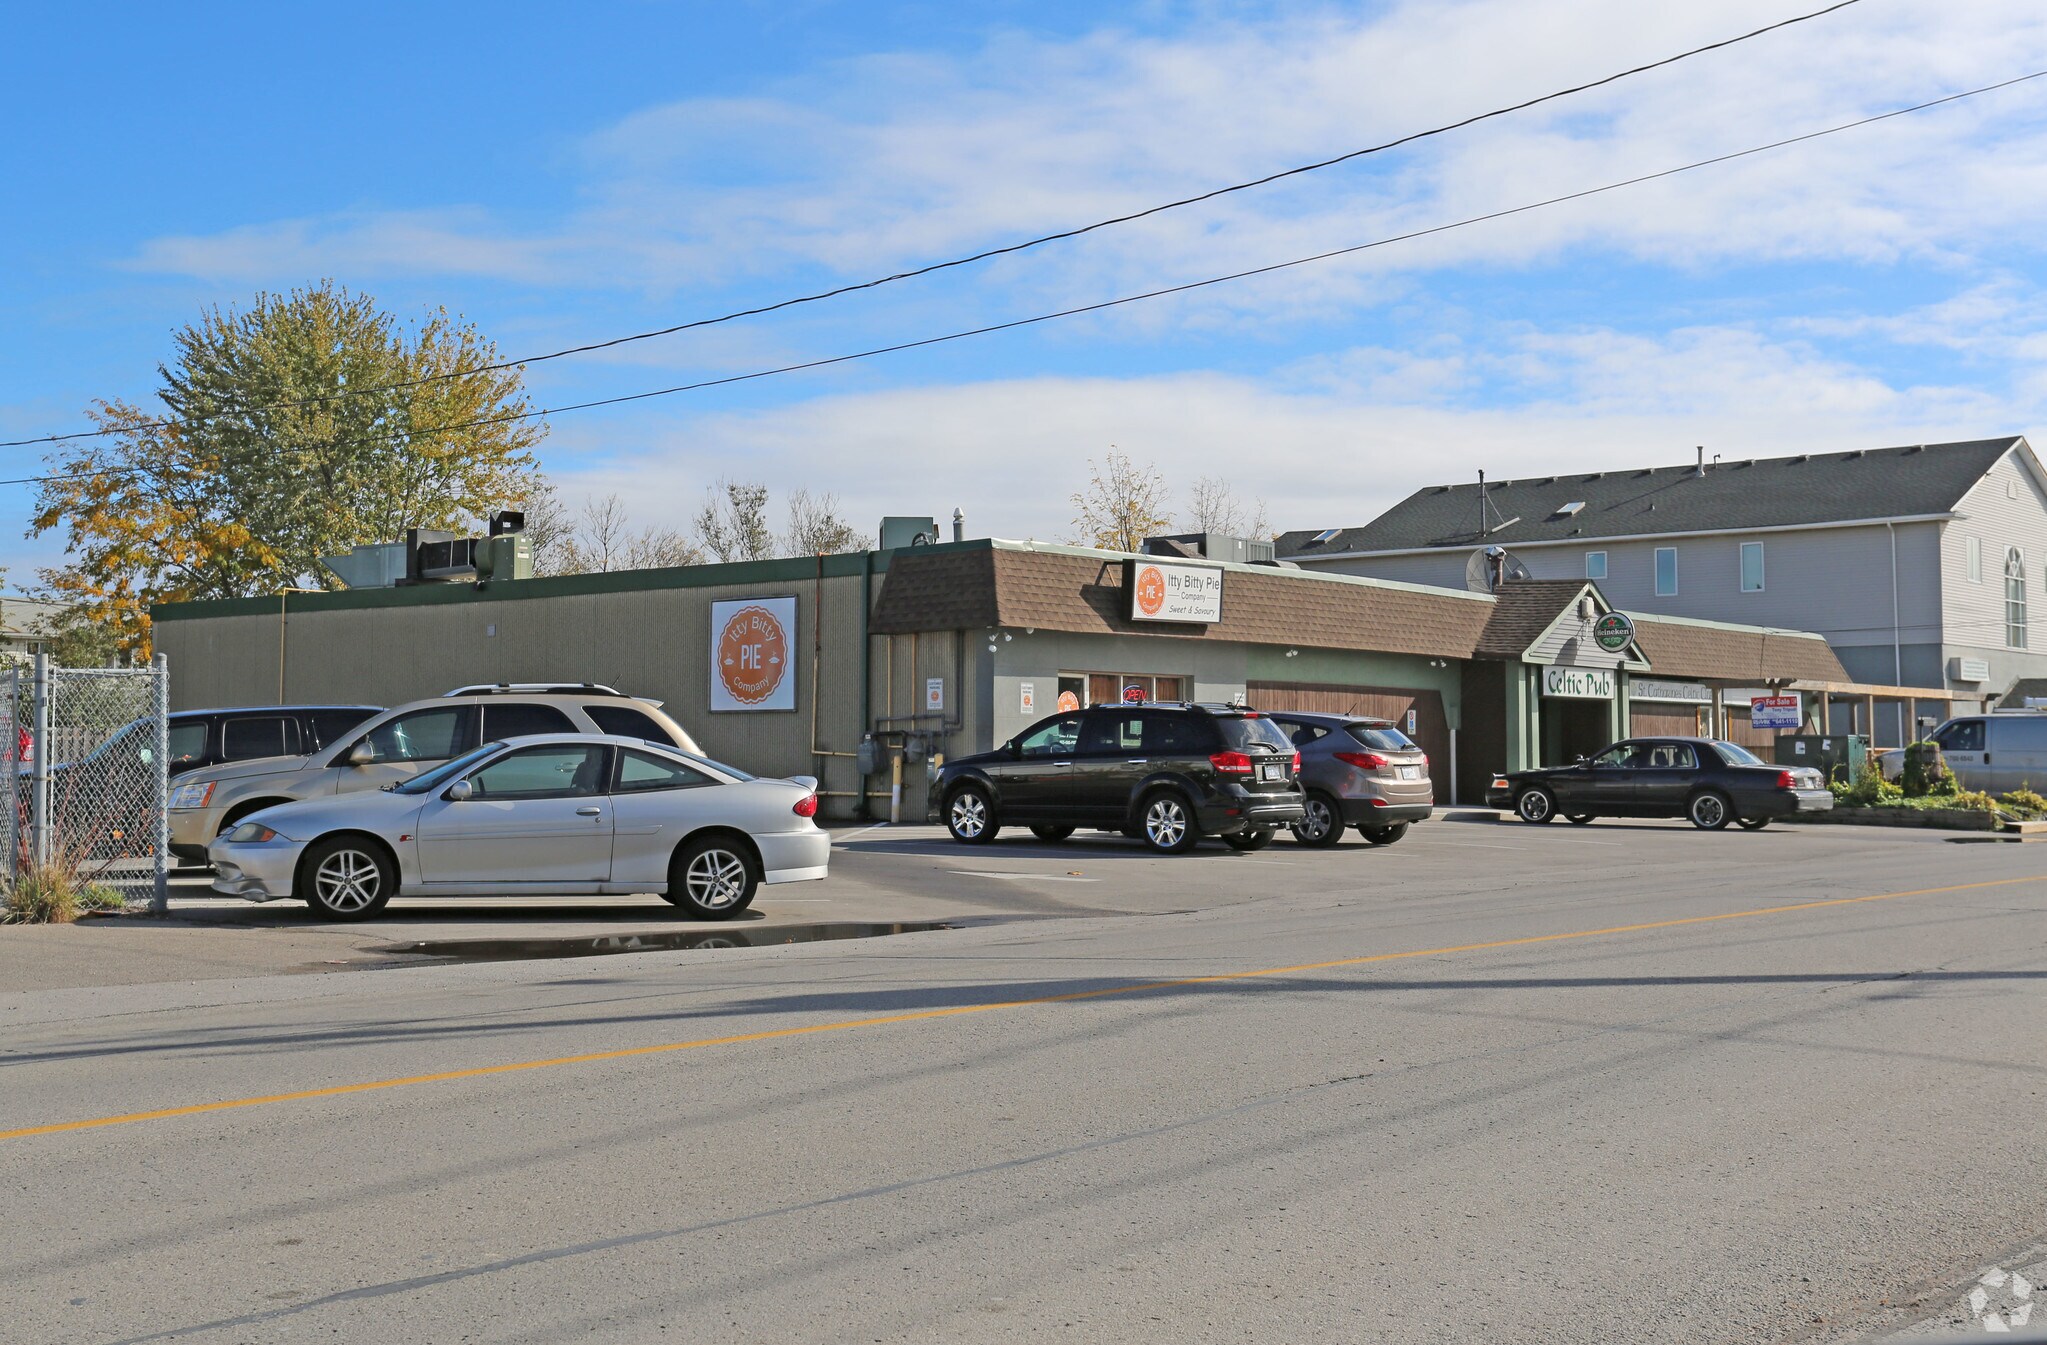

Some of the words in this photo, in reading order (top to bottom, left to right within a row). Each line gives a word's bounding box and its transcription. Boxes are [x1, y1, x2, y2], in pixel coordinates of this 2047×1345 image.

[1146, 585, 1156, 598] PIE
[1168, 574, 1182, 590] Itty
[1184, 575, 1204, 592] Bitty
[1206, 577, 1220, 590] Pie
[1181, 592, 1206, 602] Company
[1169, 605, 1187, 614] Sweet
[1187, 606, 1193, 614] &
[1194, 607, 1216, 617] Savoury
[729, 620, 748, 642] Itty
[751, 616, 777, 642] Bitty
[740, 644, 762, 670] PIE
[733, 676, 769, 694] Company
[1548, 668, 1582, 695] Celtic
[1585, 671, 1610, 696] Pub
[1124, 689, 1147, 701] OPEN
